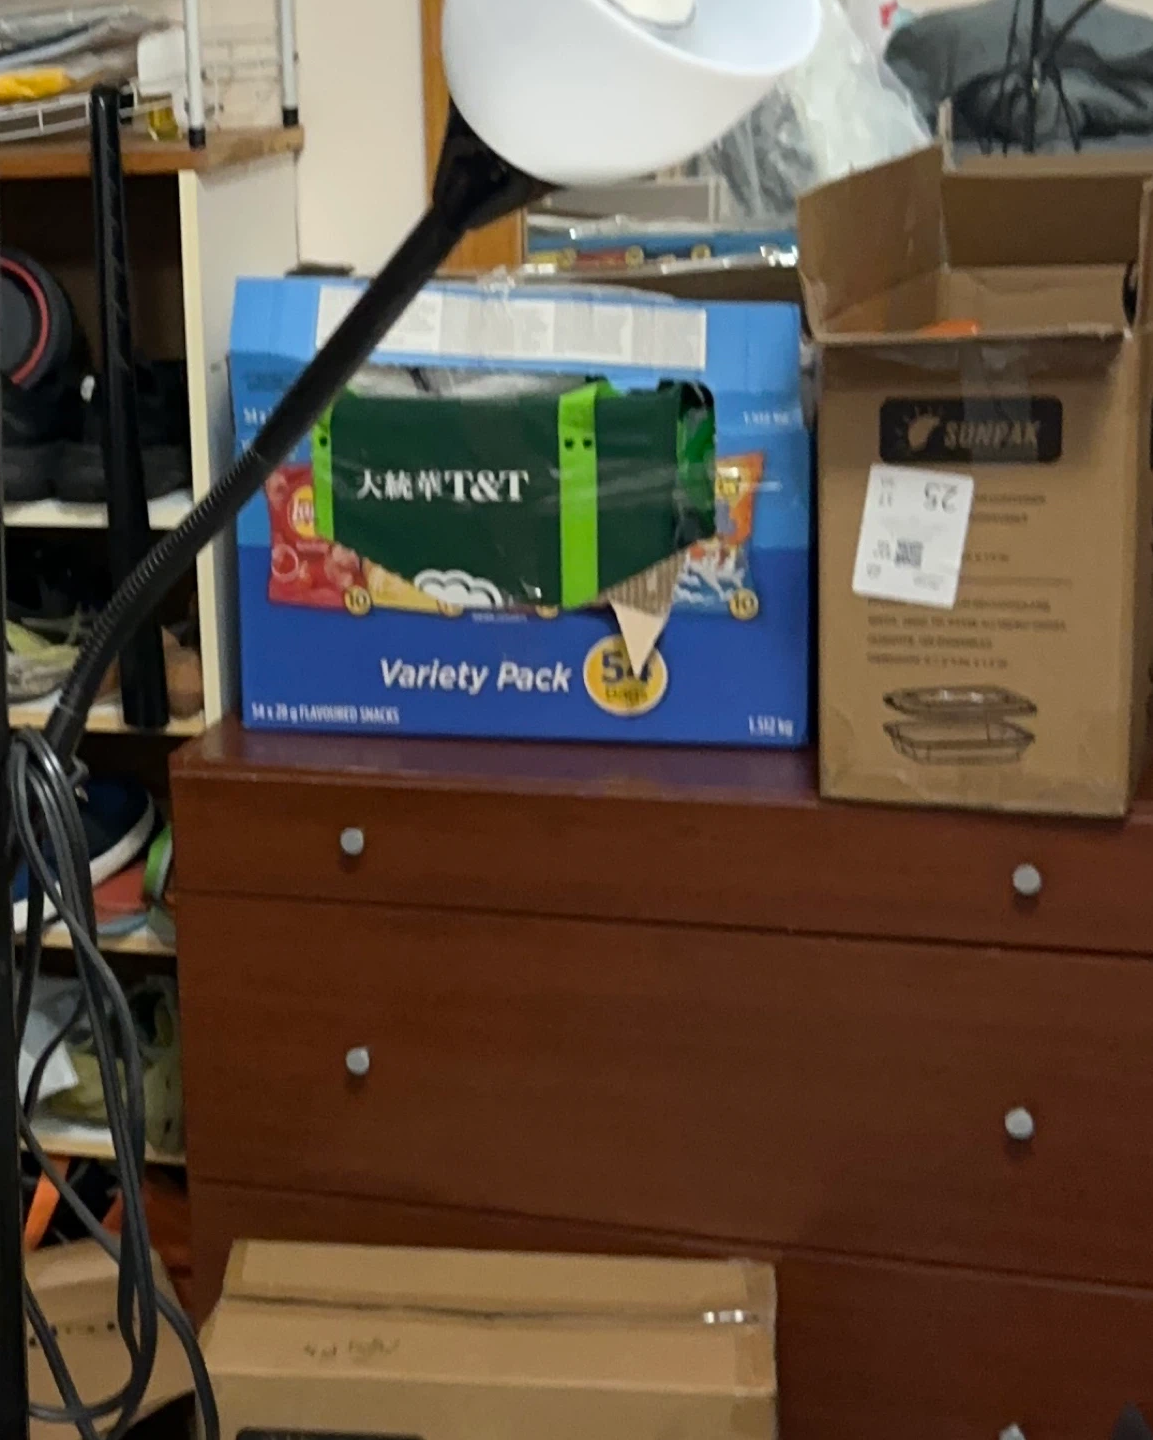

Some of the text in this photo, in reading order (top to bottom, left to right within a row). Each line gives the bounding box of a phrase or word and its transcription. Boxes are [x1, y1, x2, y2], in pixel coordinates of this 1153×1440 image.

[944, 421, 1041, 449] SUNPAK
[380, 657, 573, 695] Variety Pack
